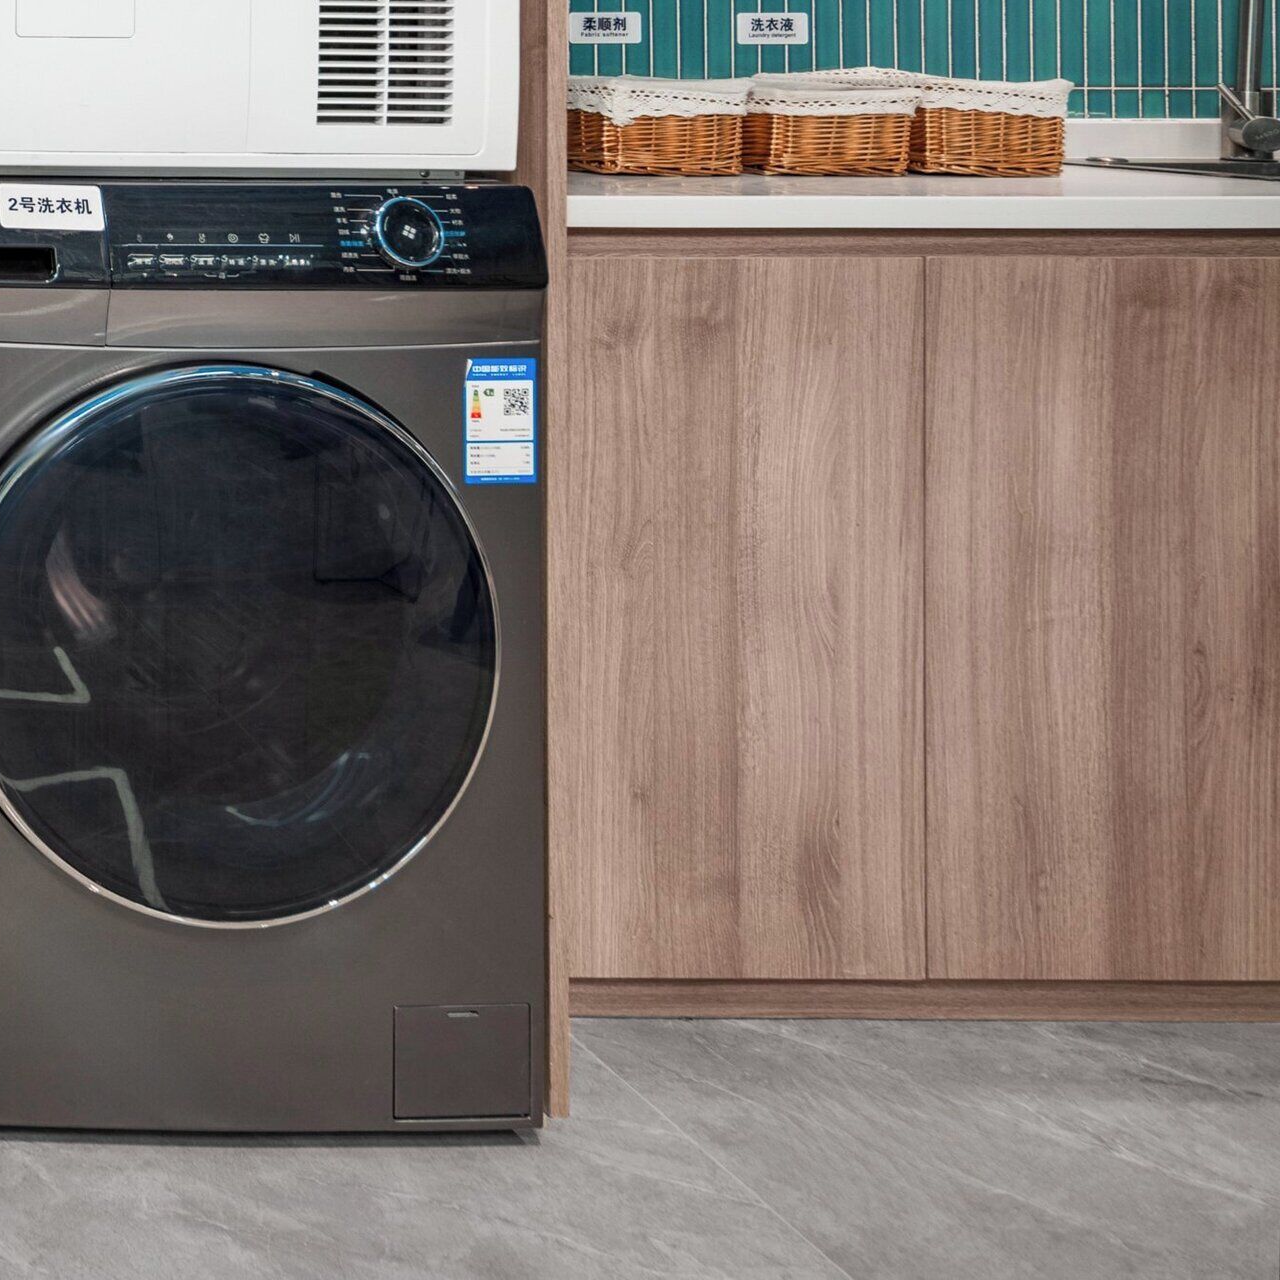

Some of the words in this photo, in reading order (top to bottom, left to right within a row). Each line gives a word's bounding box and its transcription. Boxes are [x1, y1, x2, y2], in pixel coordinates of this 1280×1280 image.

[583, 17, 627, 32] 柔顺剂
[751, 18, 794, 32] 洗衣液
[8, 197, 92, 214] 2号洗衣机
